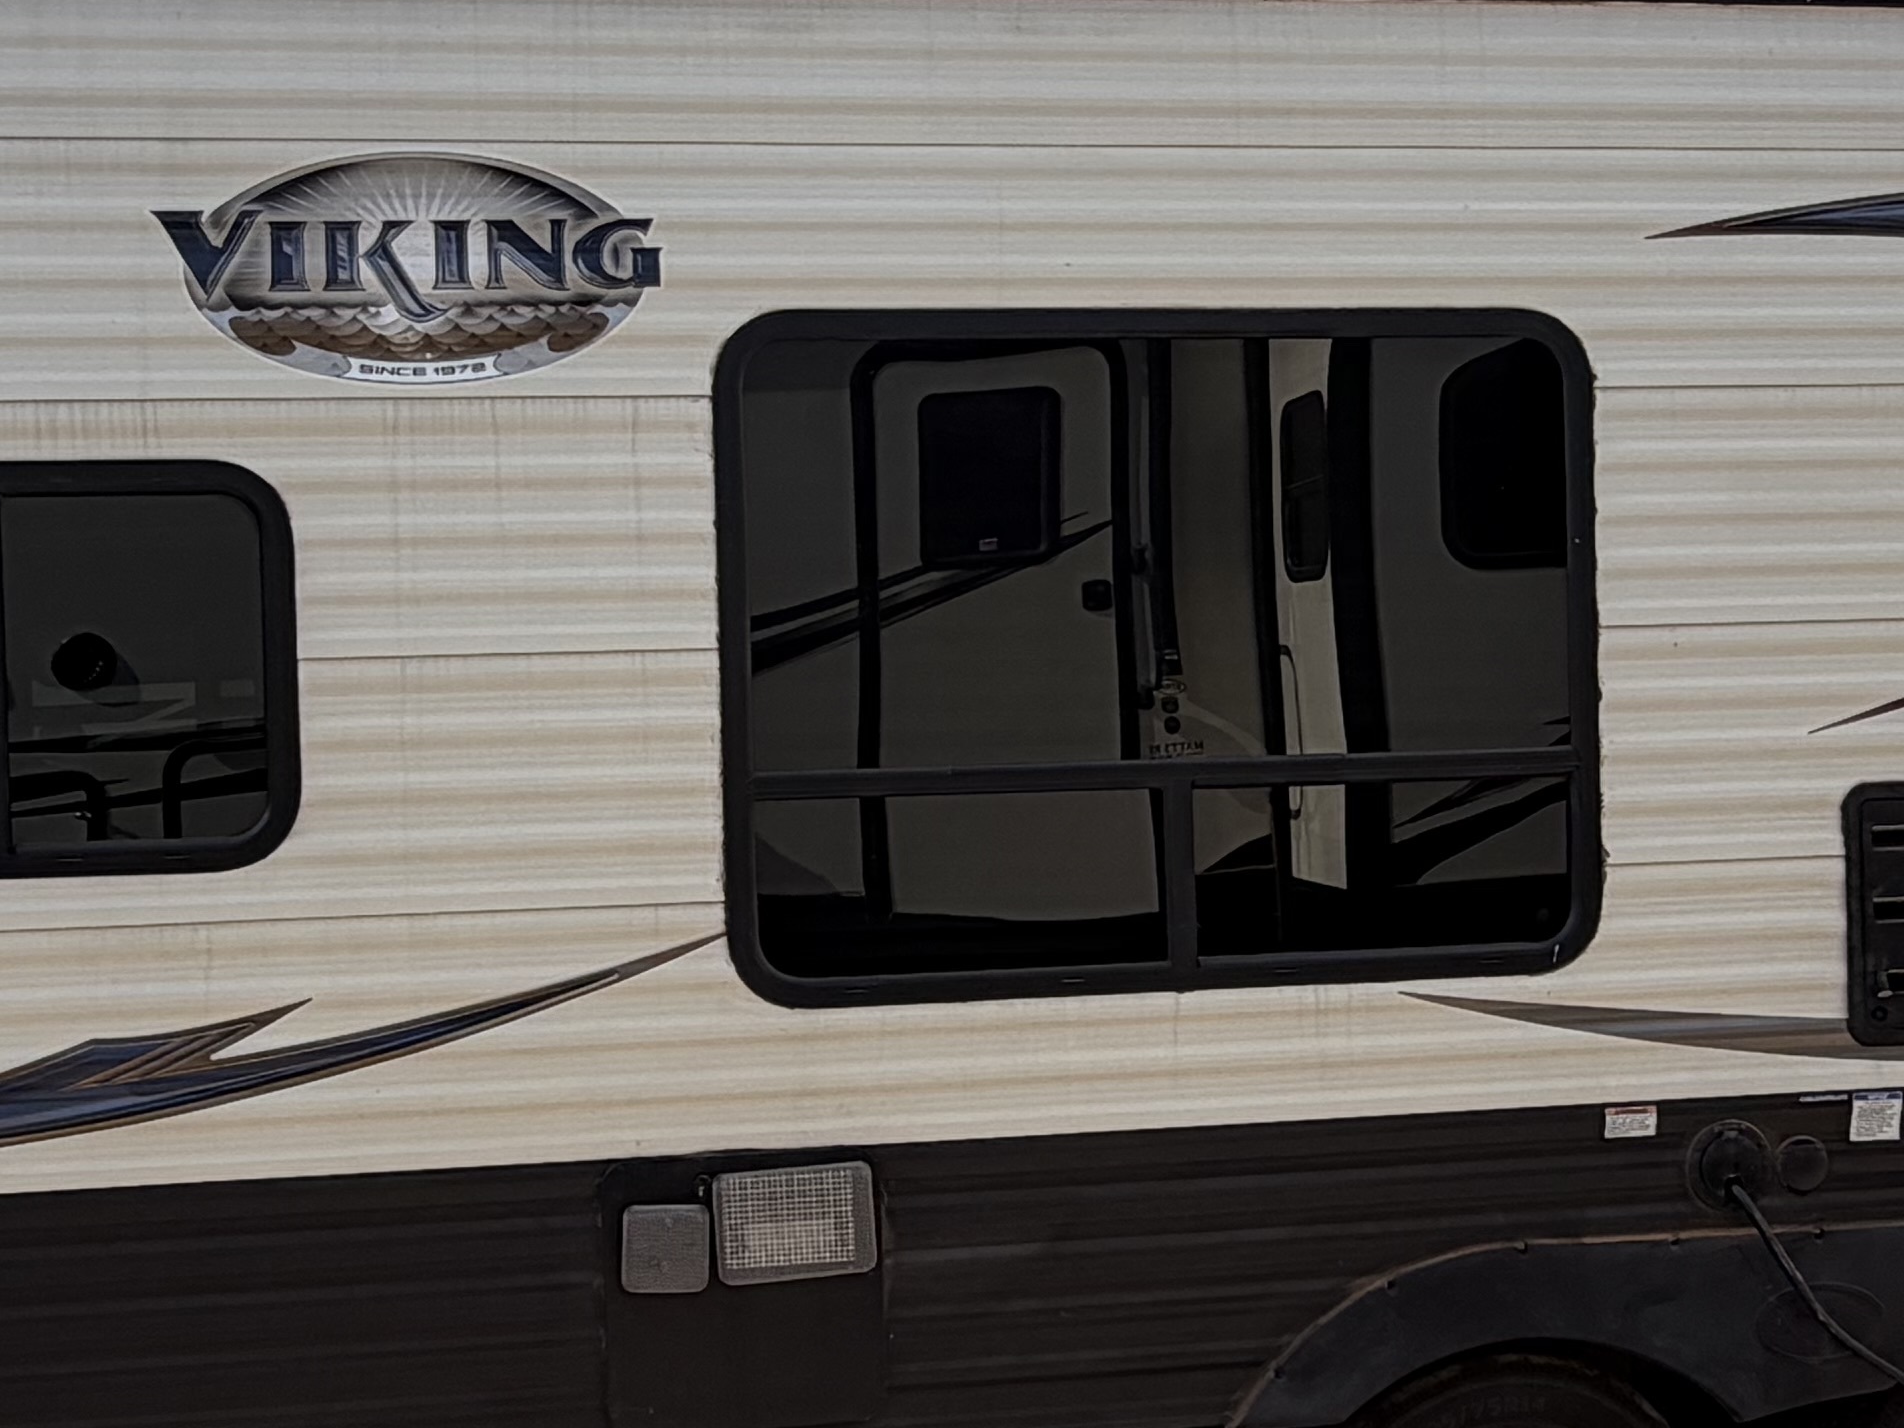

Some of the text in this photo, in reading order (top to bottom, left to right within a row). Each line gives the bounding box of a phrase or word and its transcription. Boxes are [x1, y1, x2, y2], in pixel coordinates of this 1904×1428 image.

[150, 209, 663, 324] VIKING
[358, 362, 487, 376] SINCE 1972
